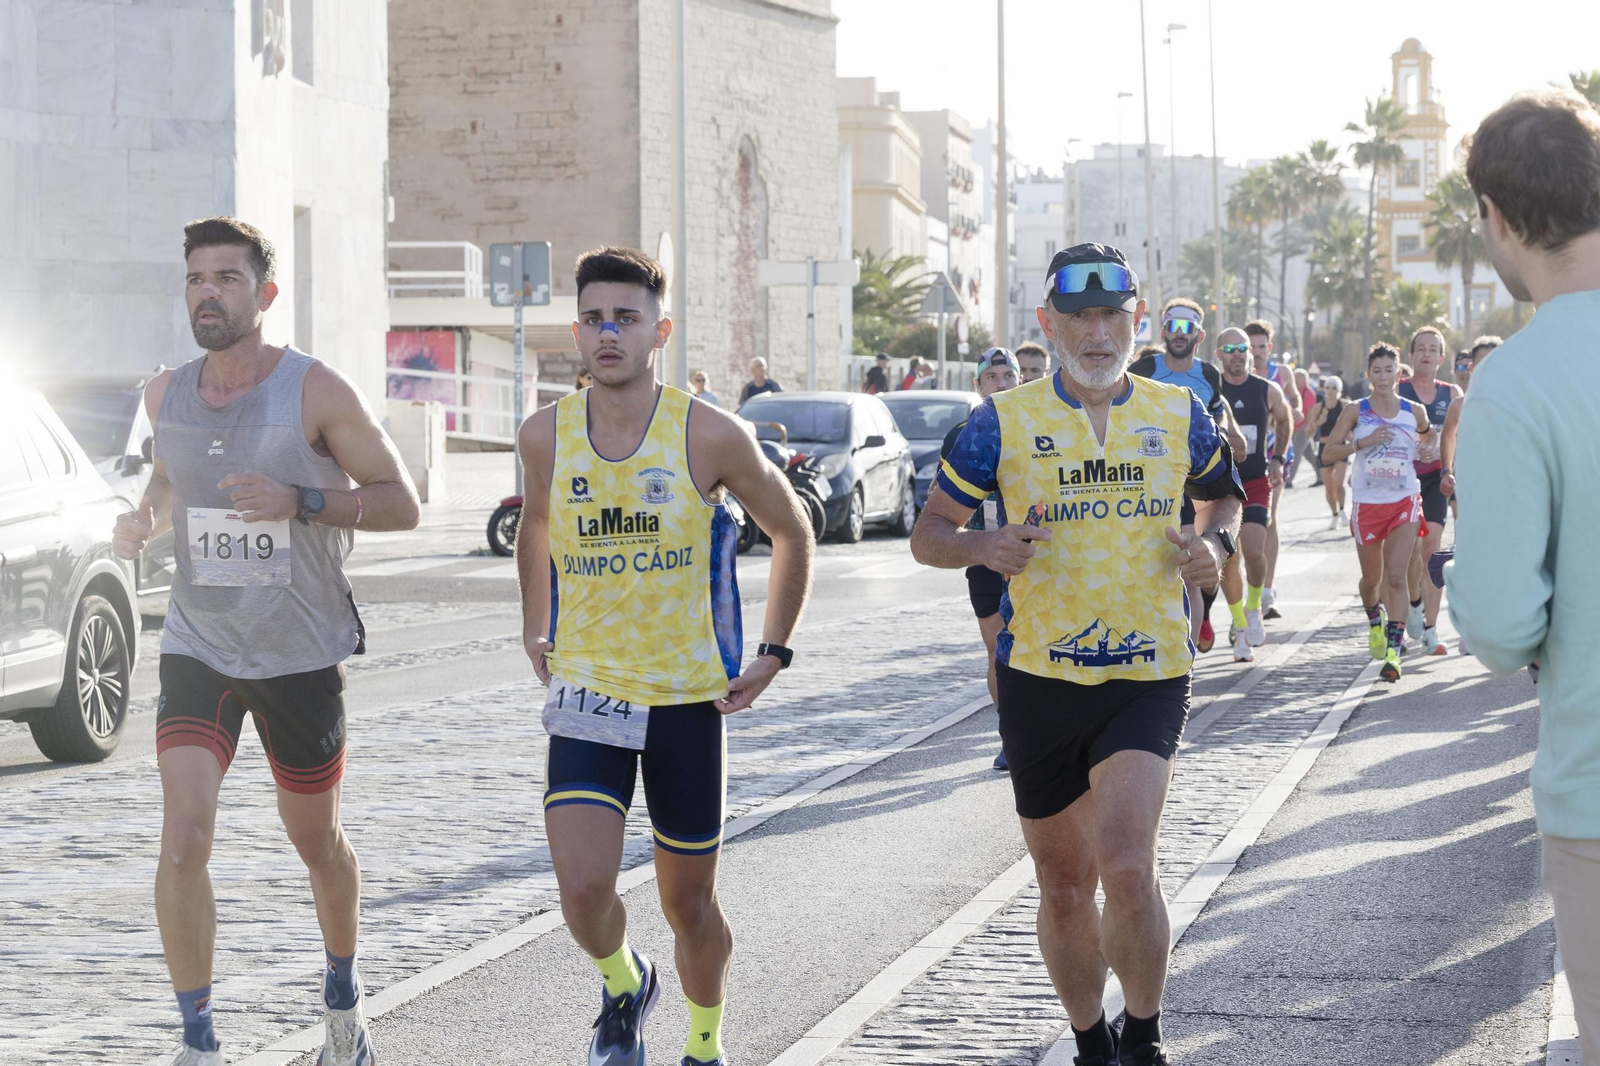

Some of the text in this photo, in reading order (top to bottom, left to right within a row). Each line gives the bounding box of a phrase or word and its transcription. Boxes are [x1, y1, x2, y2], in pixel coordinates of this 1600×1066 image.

[1073, 488, 1101, 496] SIENTA
[1030, 493, 1176, 523] LIMPO CÁDIZ
[197, 531, 274, 560] 1819
[633, 545, 693, 573] CÁDIZ
[555, 686, 632, 720] 1124
